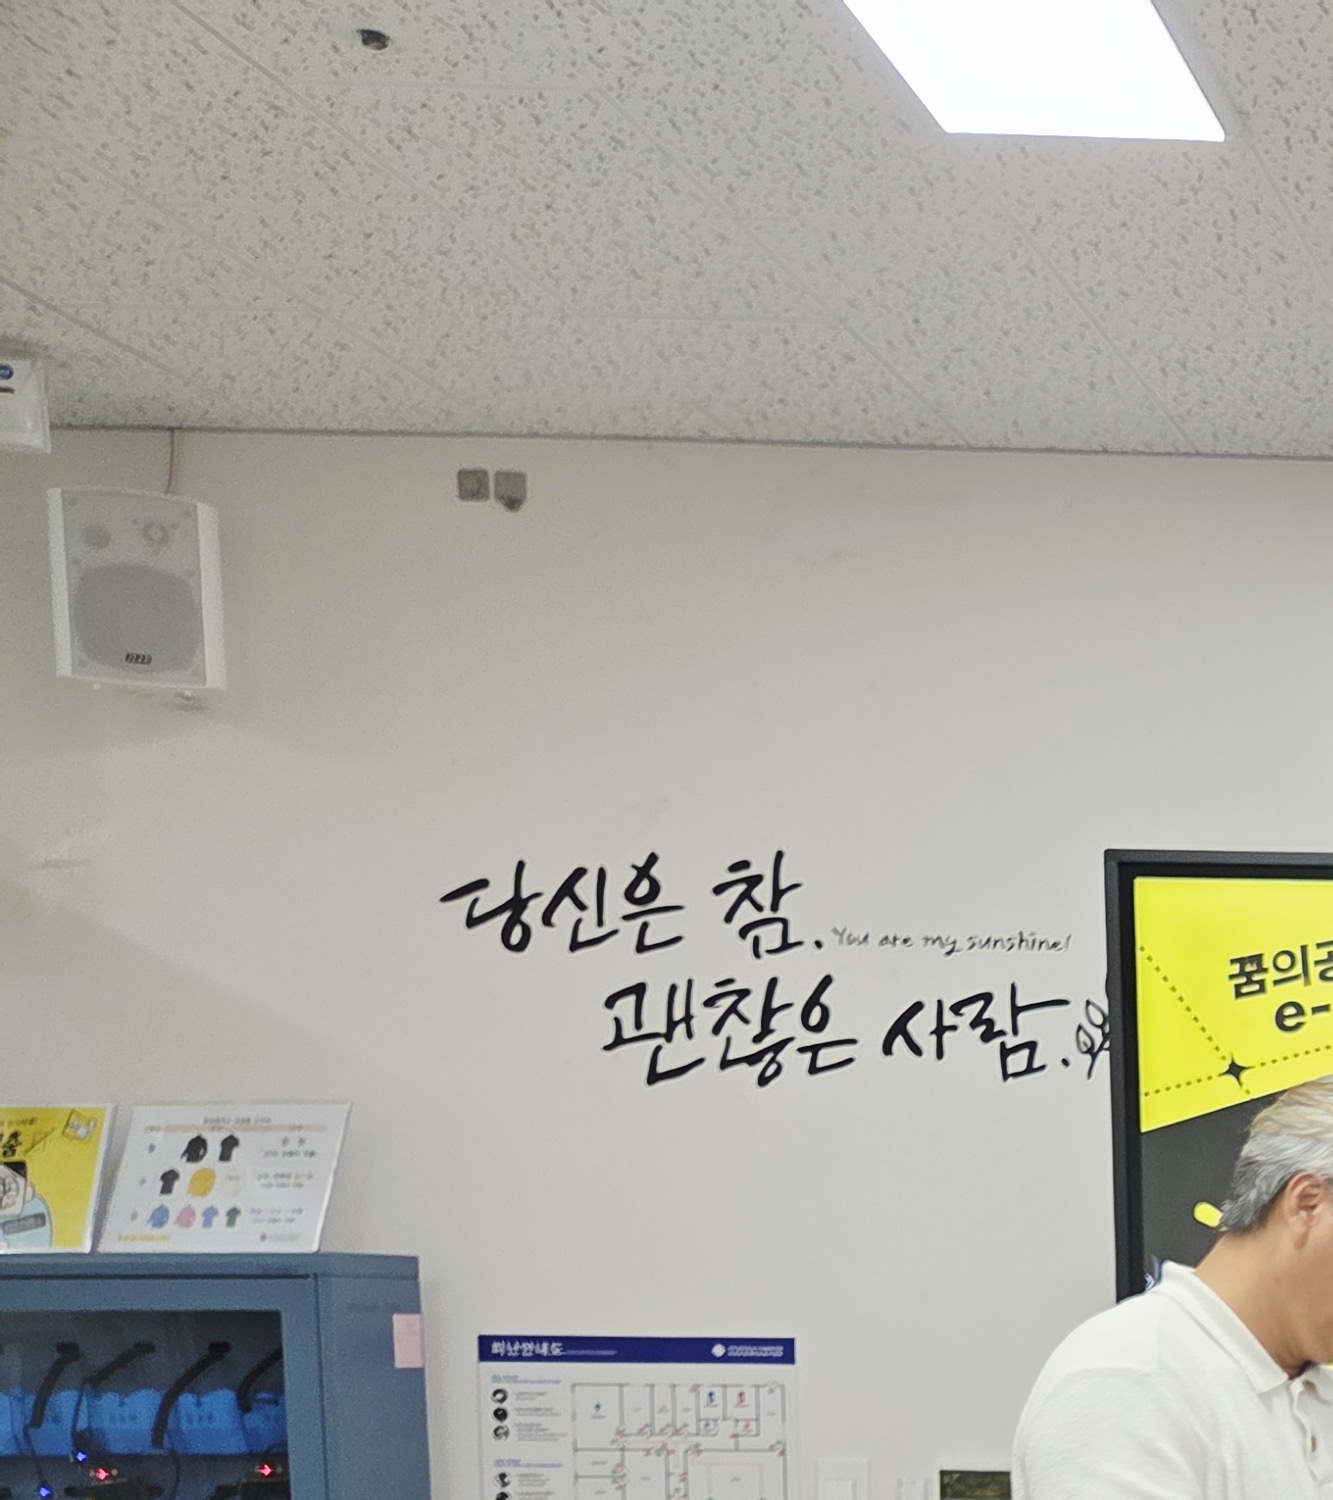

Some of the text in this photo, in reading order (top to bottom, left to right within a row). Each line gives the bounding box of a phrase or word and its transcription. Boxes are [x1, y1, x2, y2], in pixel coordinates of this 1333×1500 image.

[440, 850, 825, 958] 당신은 참.
[831, 926, 1073, 958] You are my sunshine!
[602, 974, 1071, 1088] 괜찮은 사람.
